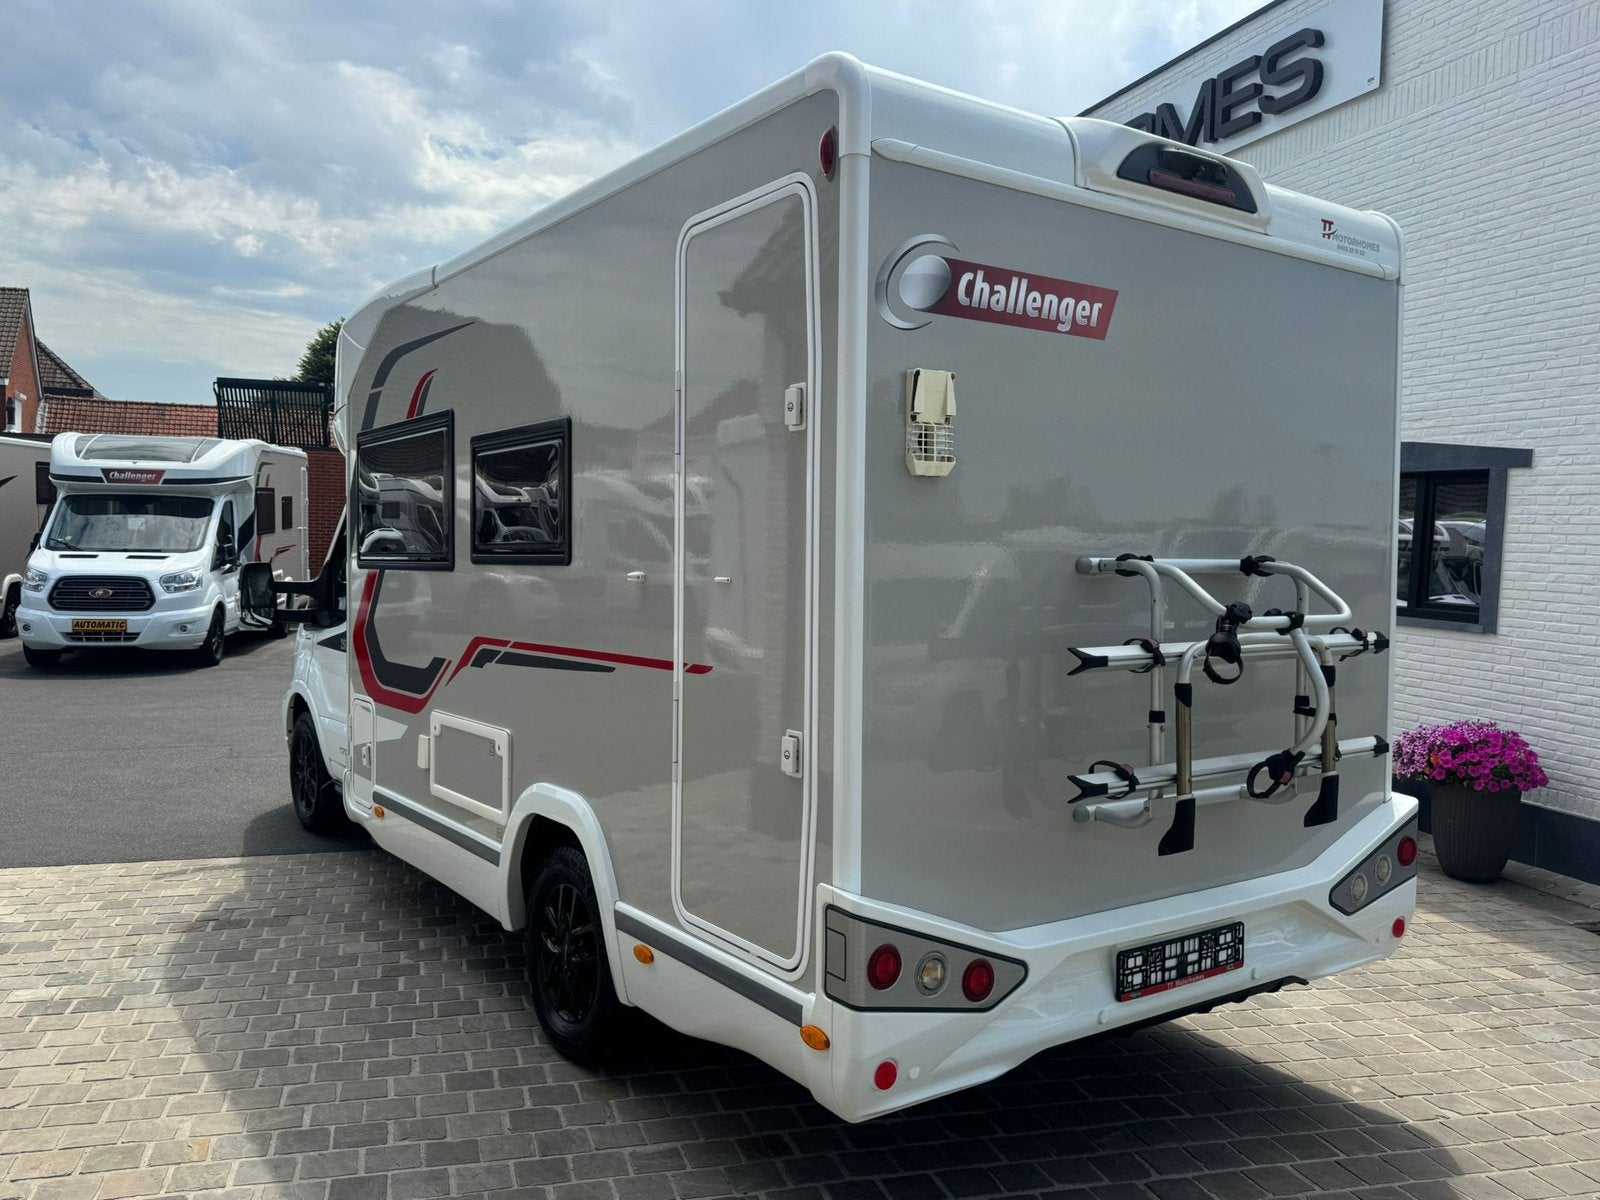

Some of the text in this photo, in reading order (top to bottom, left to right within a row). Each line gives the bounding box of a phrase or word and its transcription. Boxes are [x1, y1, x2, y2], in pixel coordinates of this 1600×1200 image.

[1332, 233, 1380, 252] MOTORHOMES
[957, 269, 1104, 332] Challenger
[109, 470, 157, 482] Challenger
[74, 620, 125, 629] AUTOMATIC
